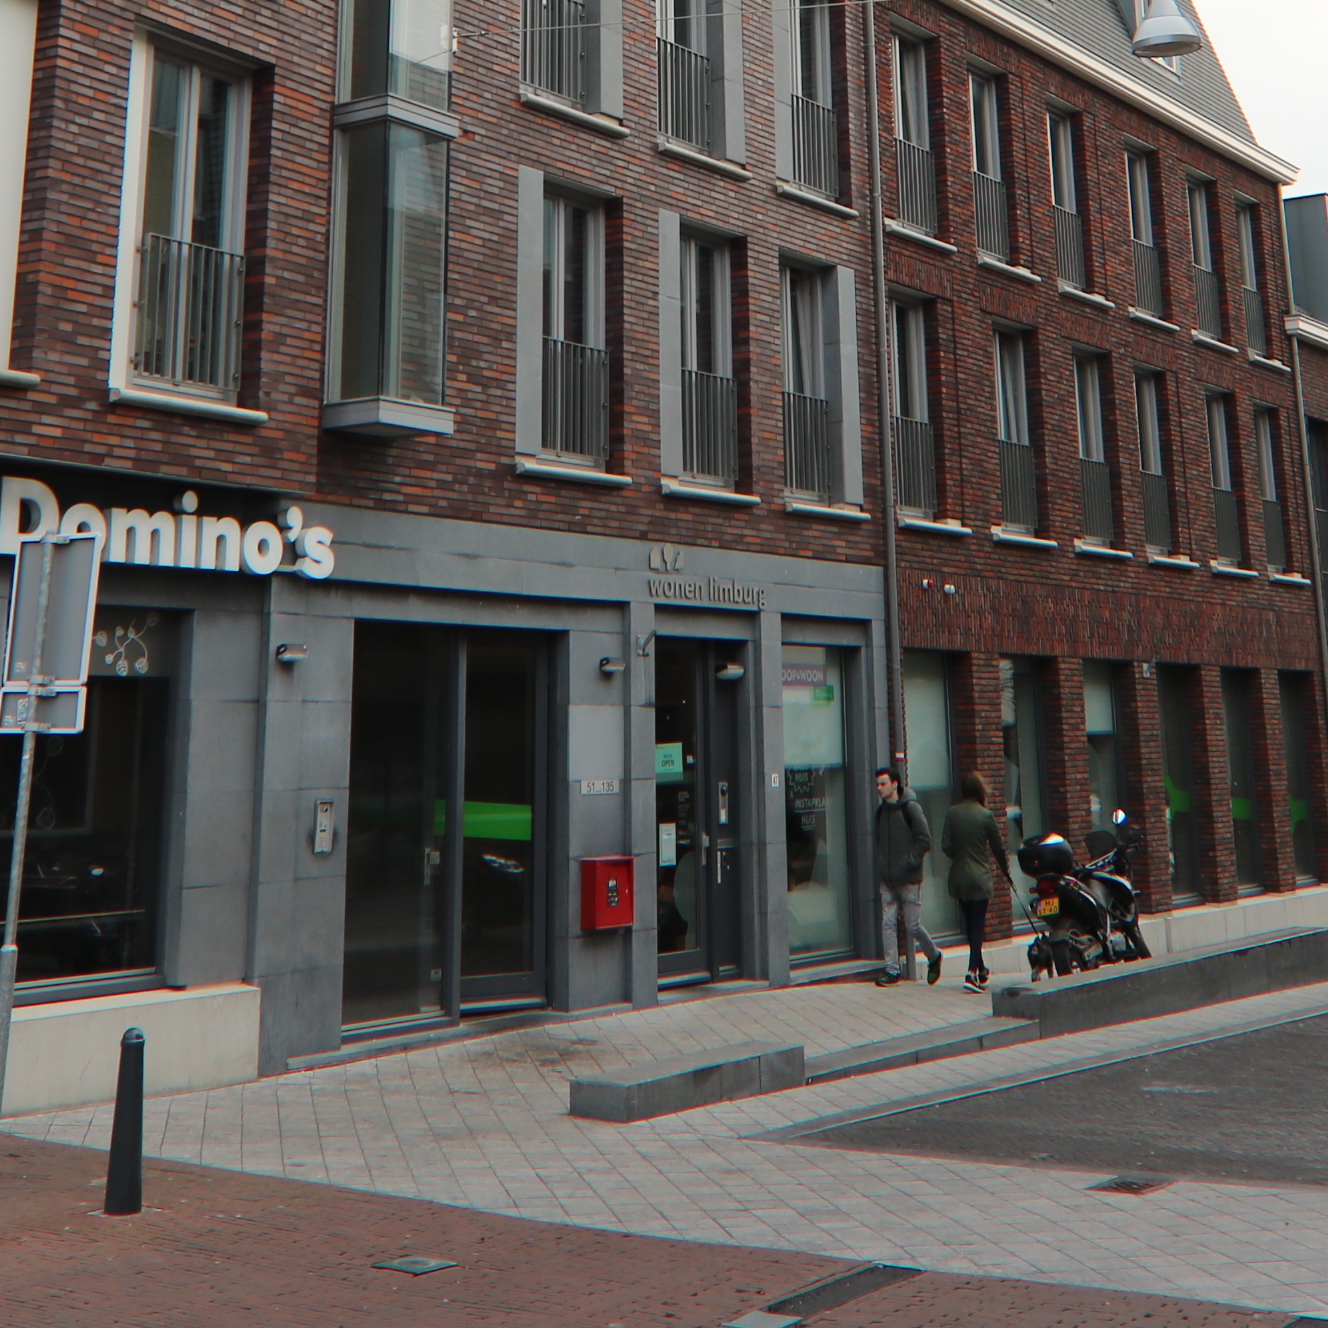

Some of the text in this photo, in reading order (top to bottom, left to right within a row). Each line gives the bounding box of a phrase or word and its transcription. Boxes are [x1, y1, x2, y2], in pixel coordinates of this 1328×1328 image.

[648, 576, 767, 611] wonen limburg
[662, 759, 675, 768] OPEN
